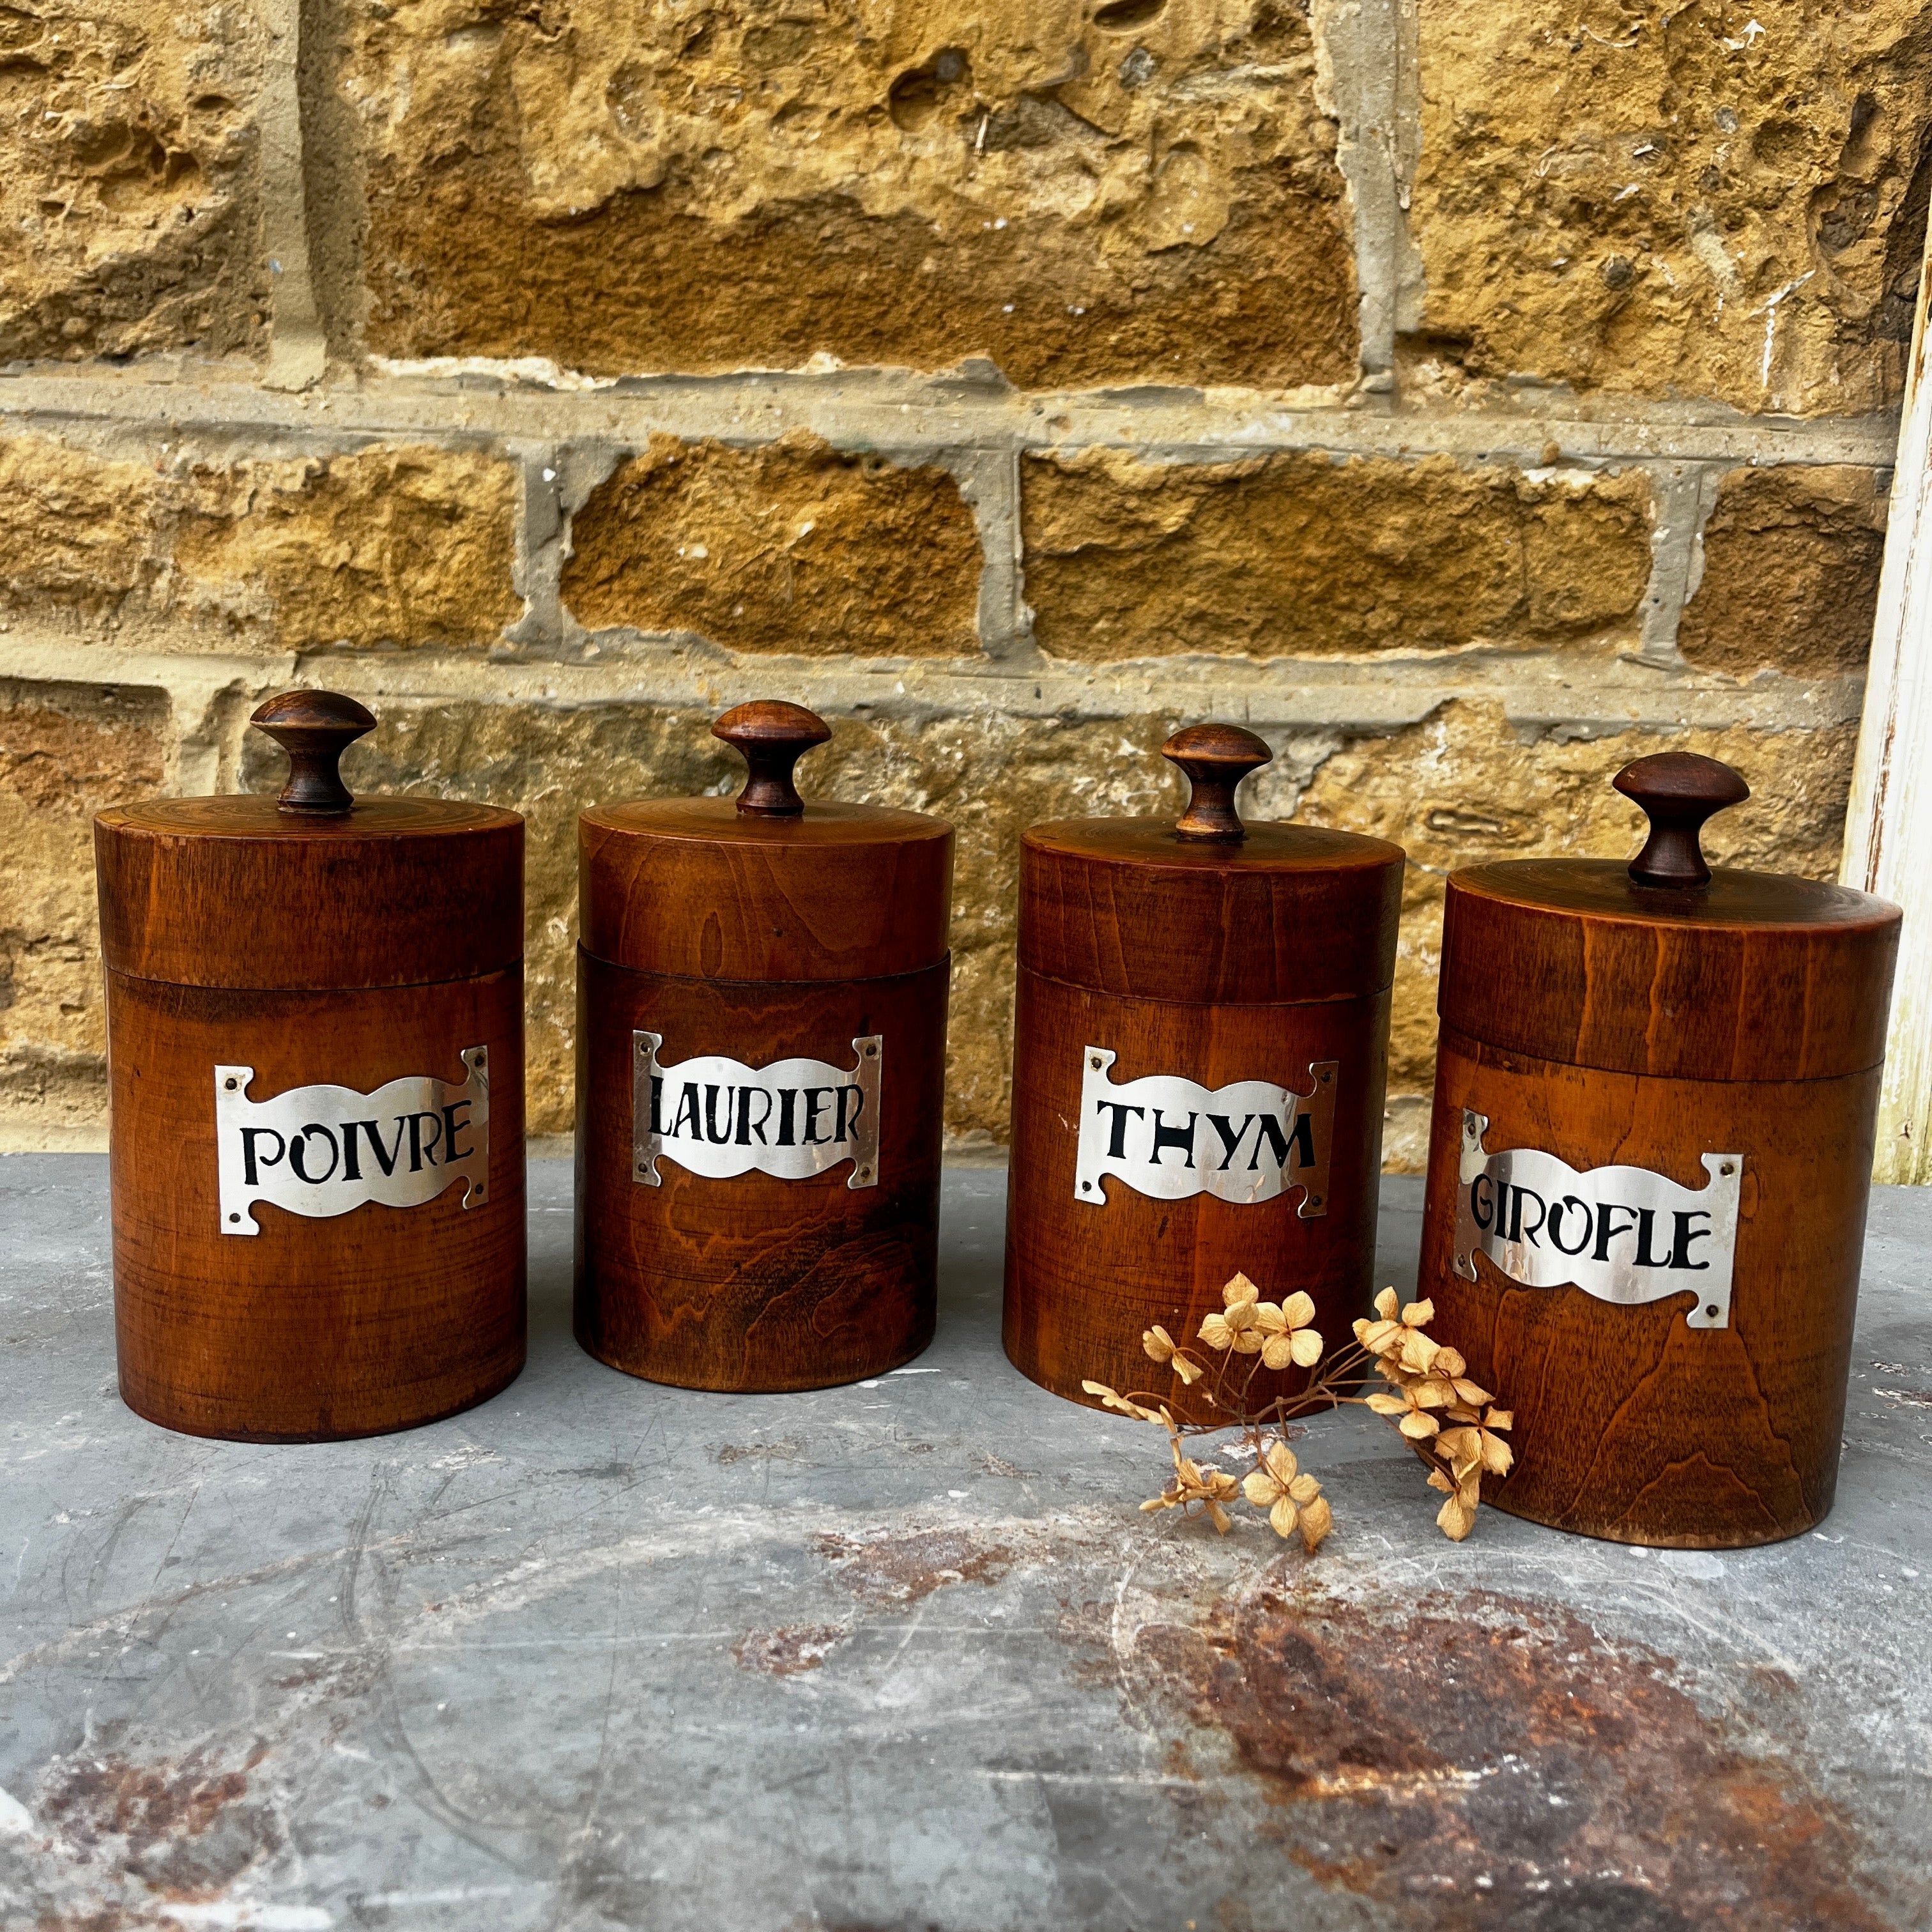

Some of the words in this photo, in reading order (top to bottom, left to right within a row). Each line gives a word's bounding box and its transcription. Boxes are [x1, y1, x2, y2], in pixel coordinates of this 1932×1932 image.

[239, 1100, 475, 1186] POIVRE
[647, 1075, 864, 1146] LAURIER
[1096, 1100, 1317, 1170] THYM
[1470, 1173, 1712, 1269] GIROFLE
